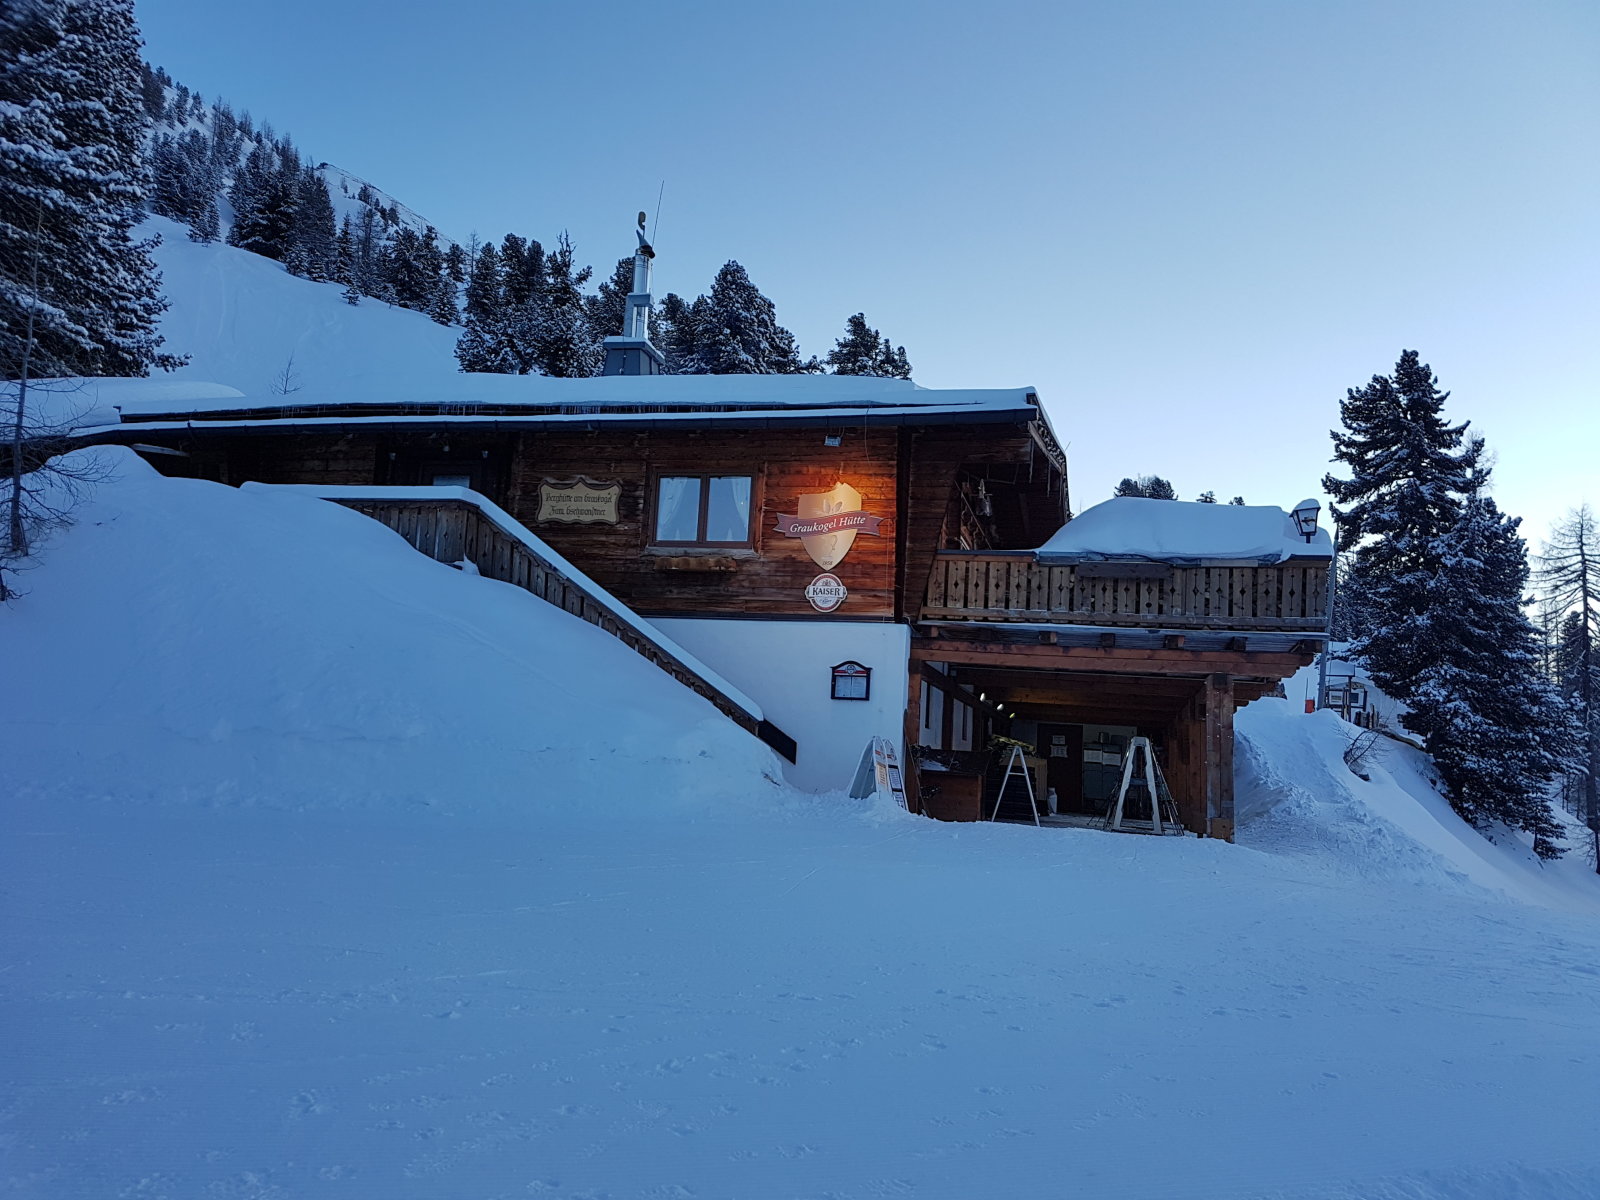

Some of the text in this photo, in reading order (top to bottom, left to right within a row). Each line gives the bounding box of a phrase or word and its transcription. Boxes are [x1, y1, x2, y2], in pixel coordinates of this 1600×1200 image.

[573, 495, 583, 503] am
[584, 493, 612, 505] Graukogel
[790, 516, 866, 532] Graukogel Hütte
[812, 587, 840, 596] KAISER
